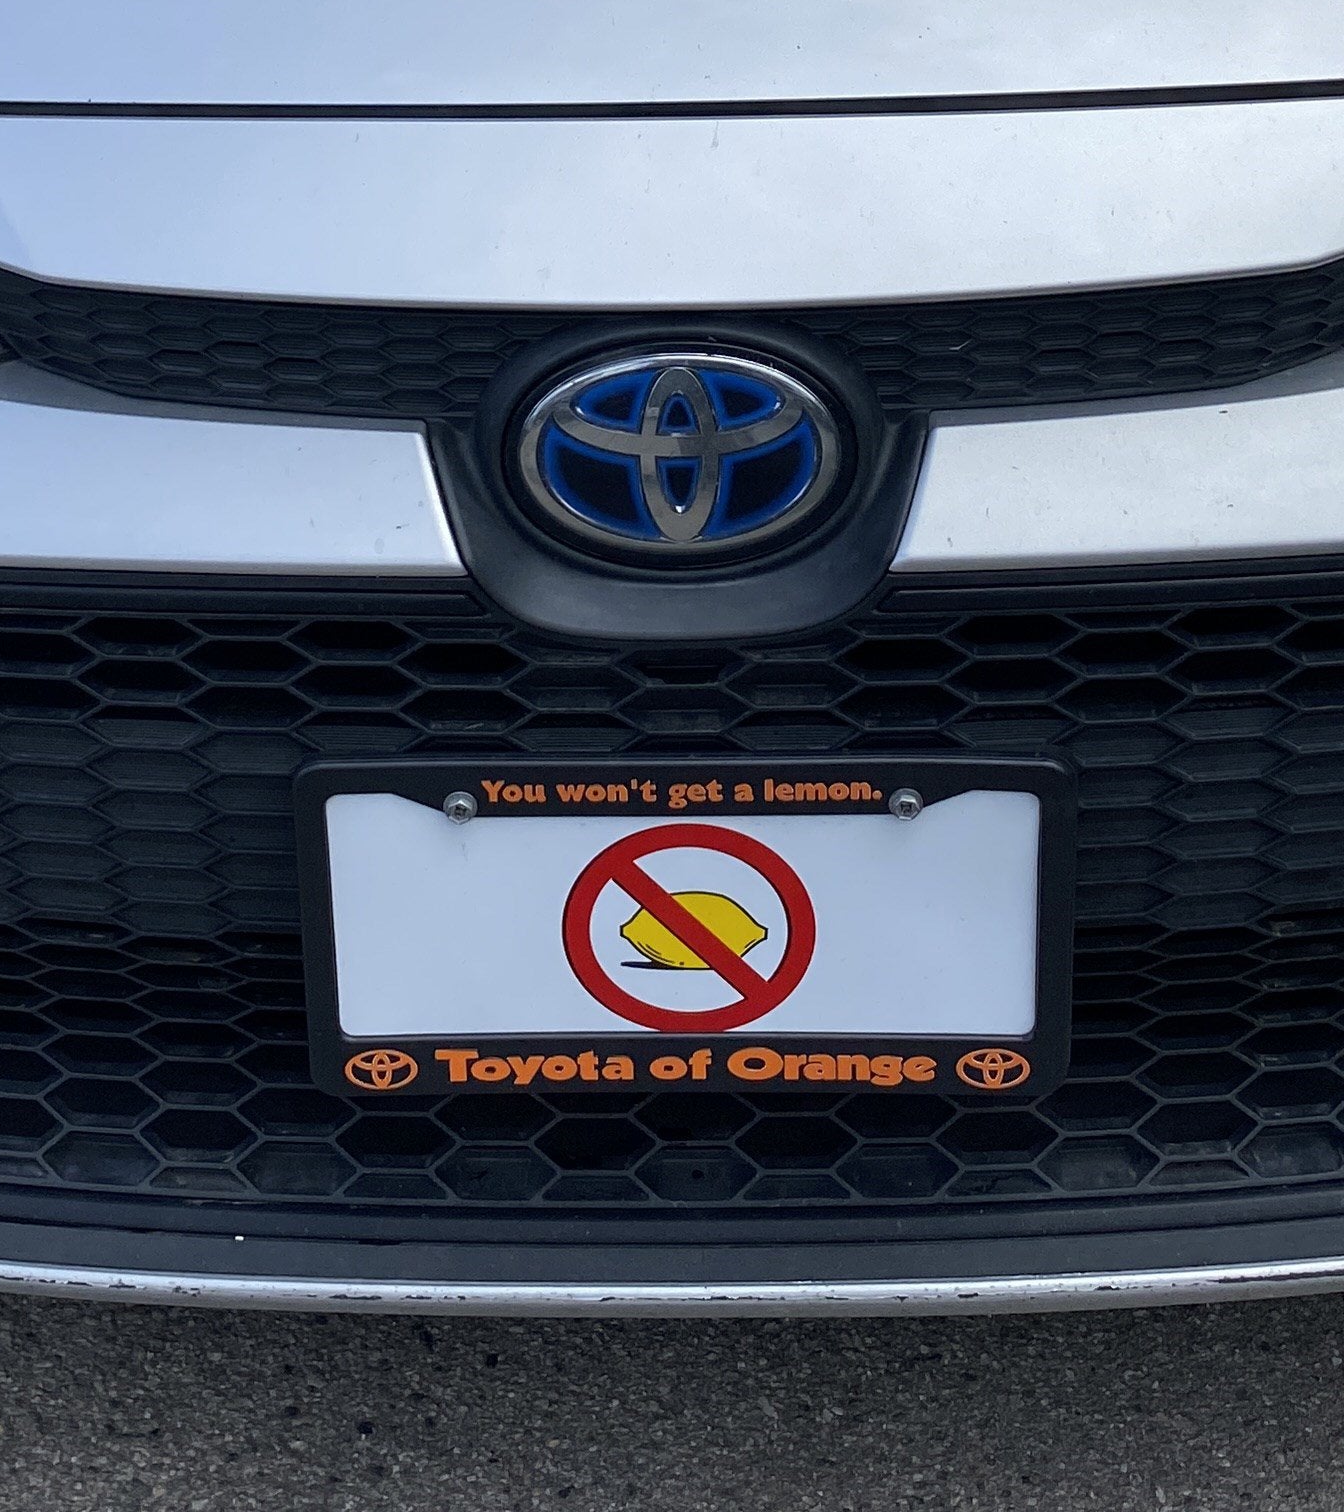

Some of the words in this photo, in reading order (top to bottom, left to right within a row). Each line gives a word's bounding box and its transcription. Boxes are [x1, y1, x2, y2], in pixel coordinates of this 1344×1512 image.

[481, 779, 547, 802] You
[555, 779, 658, 803] won't
[667, 779, 724, 810] get
[733, 784, 755, 803] a
[764, 778, 884, 803] lemon.
[435, 1047, 634, 1085] Toyota
[649, 1047, 712, 1083] of
[726, 1046, 938, 1087] Orange
